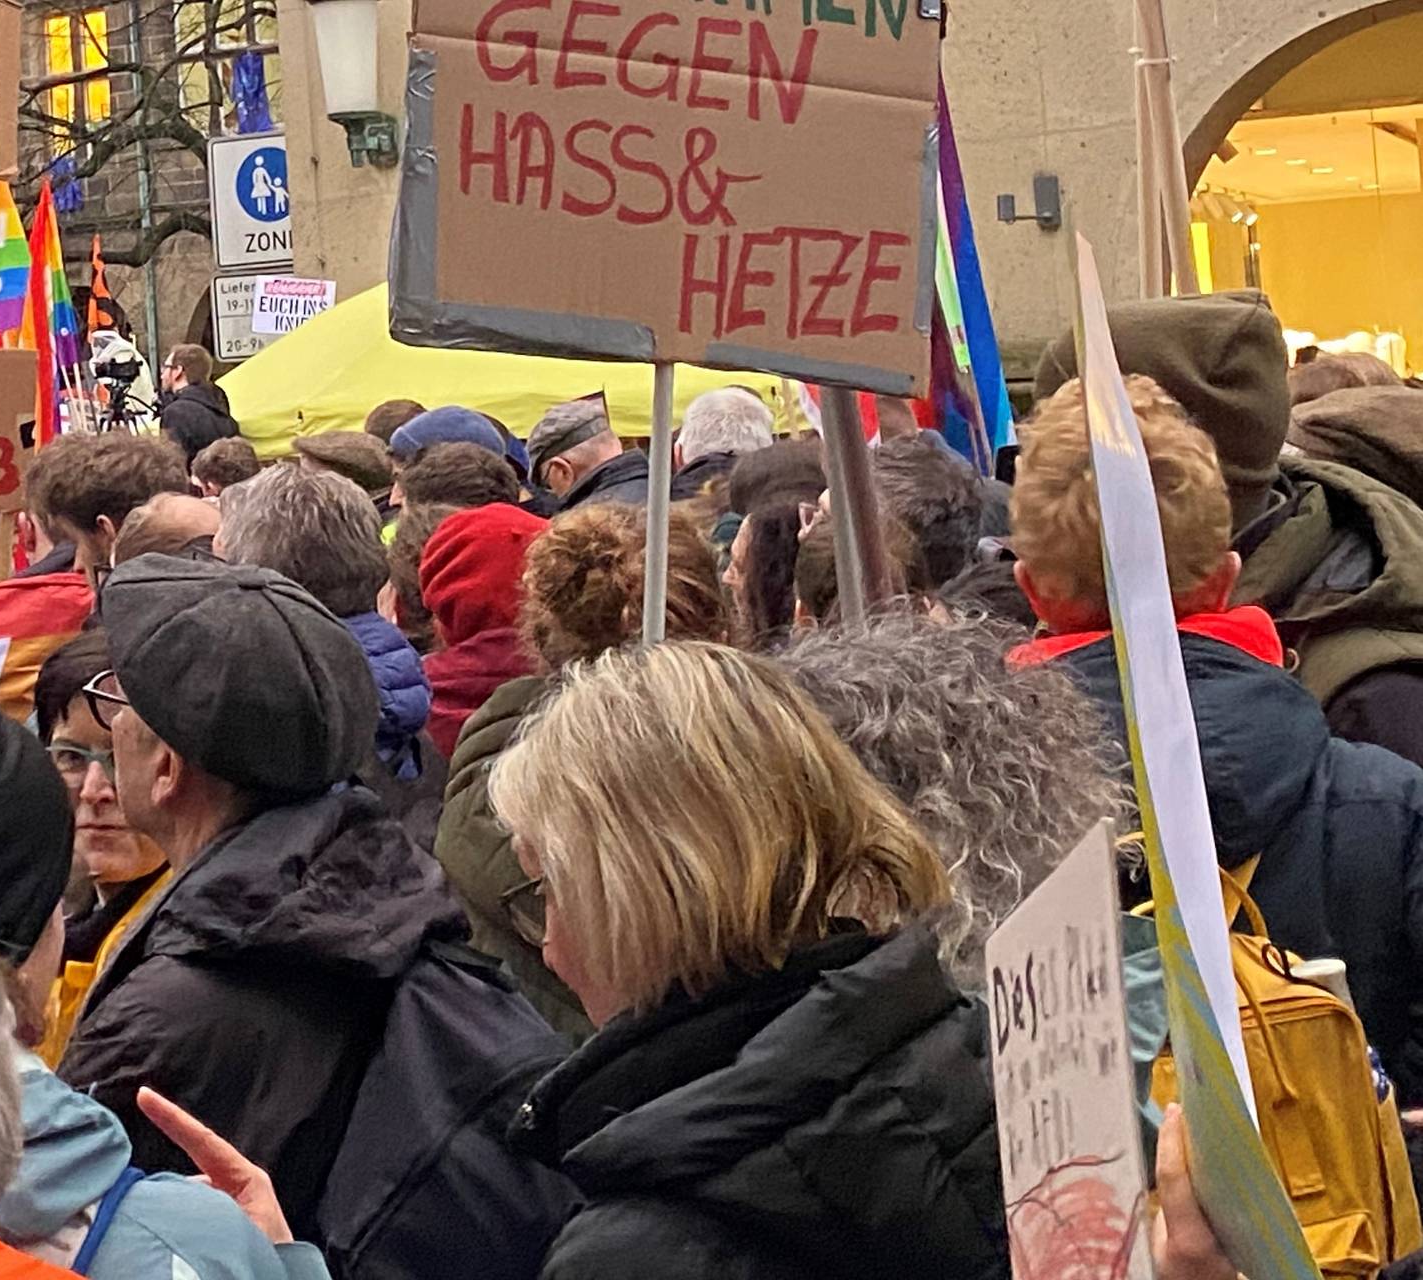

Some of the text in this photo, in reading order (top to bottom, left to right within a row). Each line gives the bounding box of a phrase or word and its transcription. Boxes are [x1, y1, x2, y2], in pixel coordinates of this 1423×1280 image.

[477, 0, 818, 124] GEGEN
[259, 296, 298, 314] EUCH
[678, 226, 911, 339] HETZE
